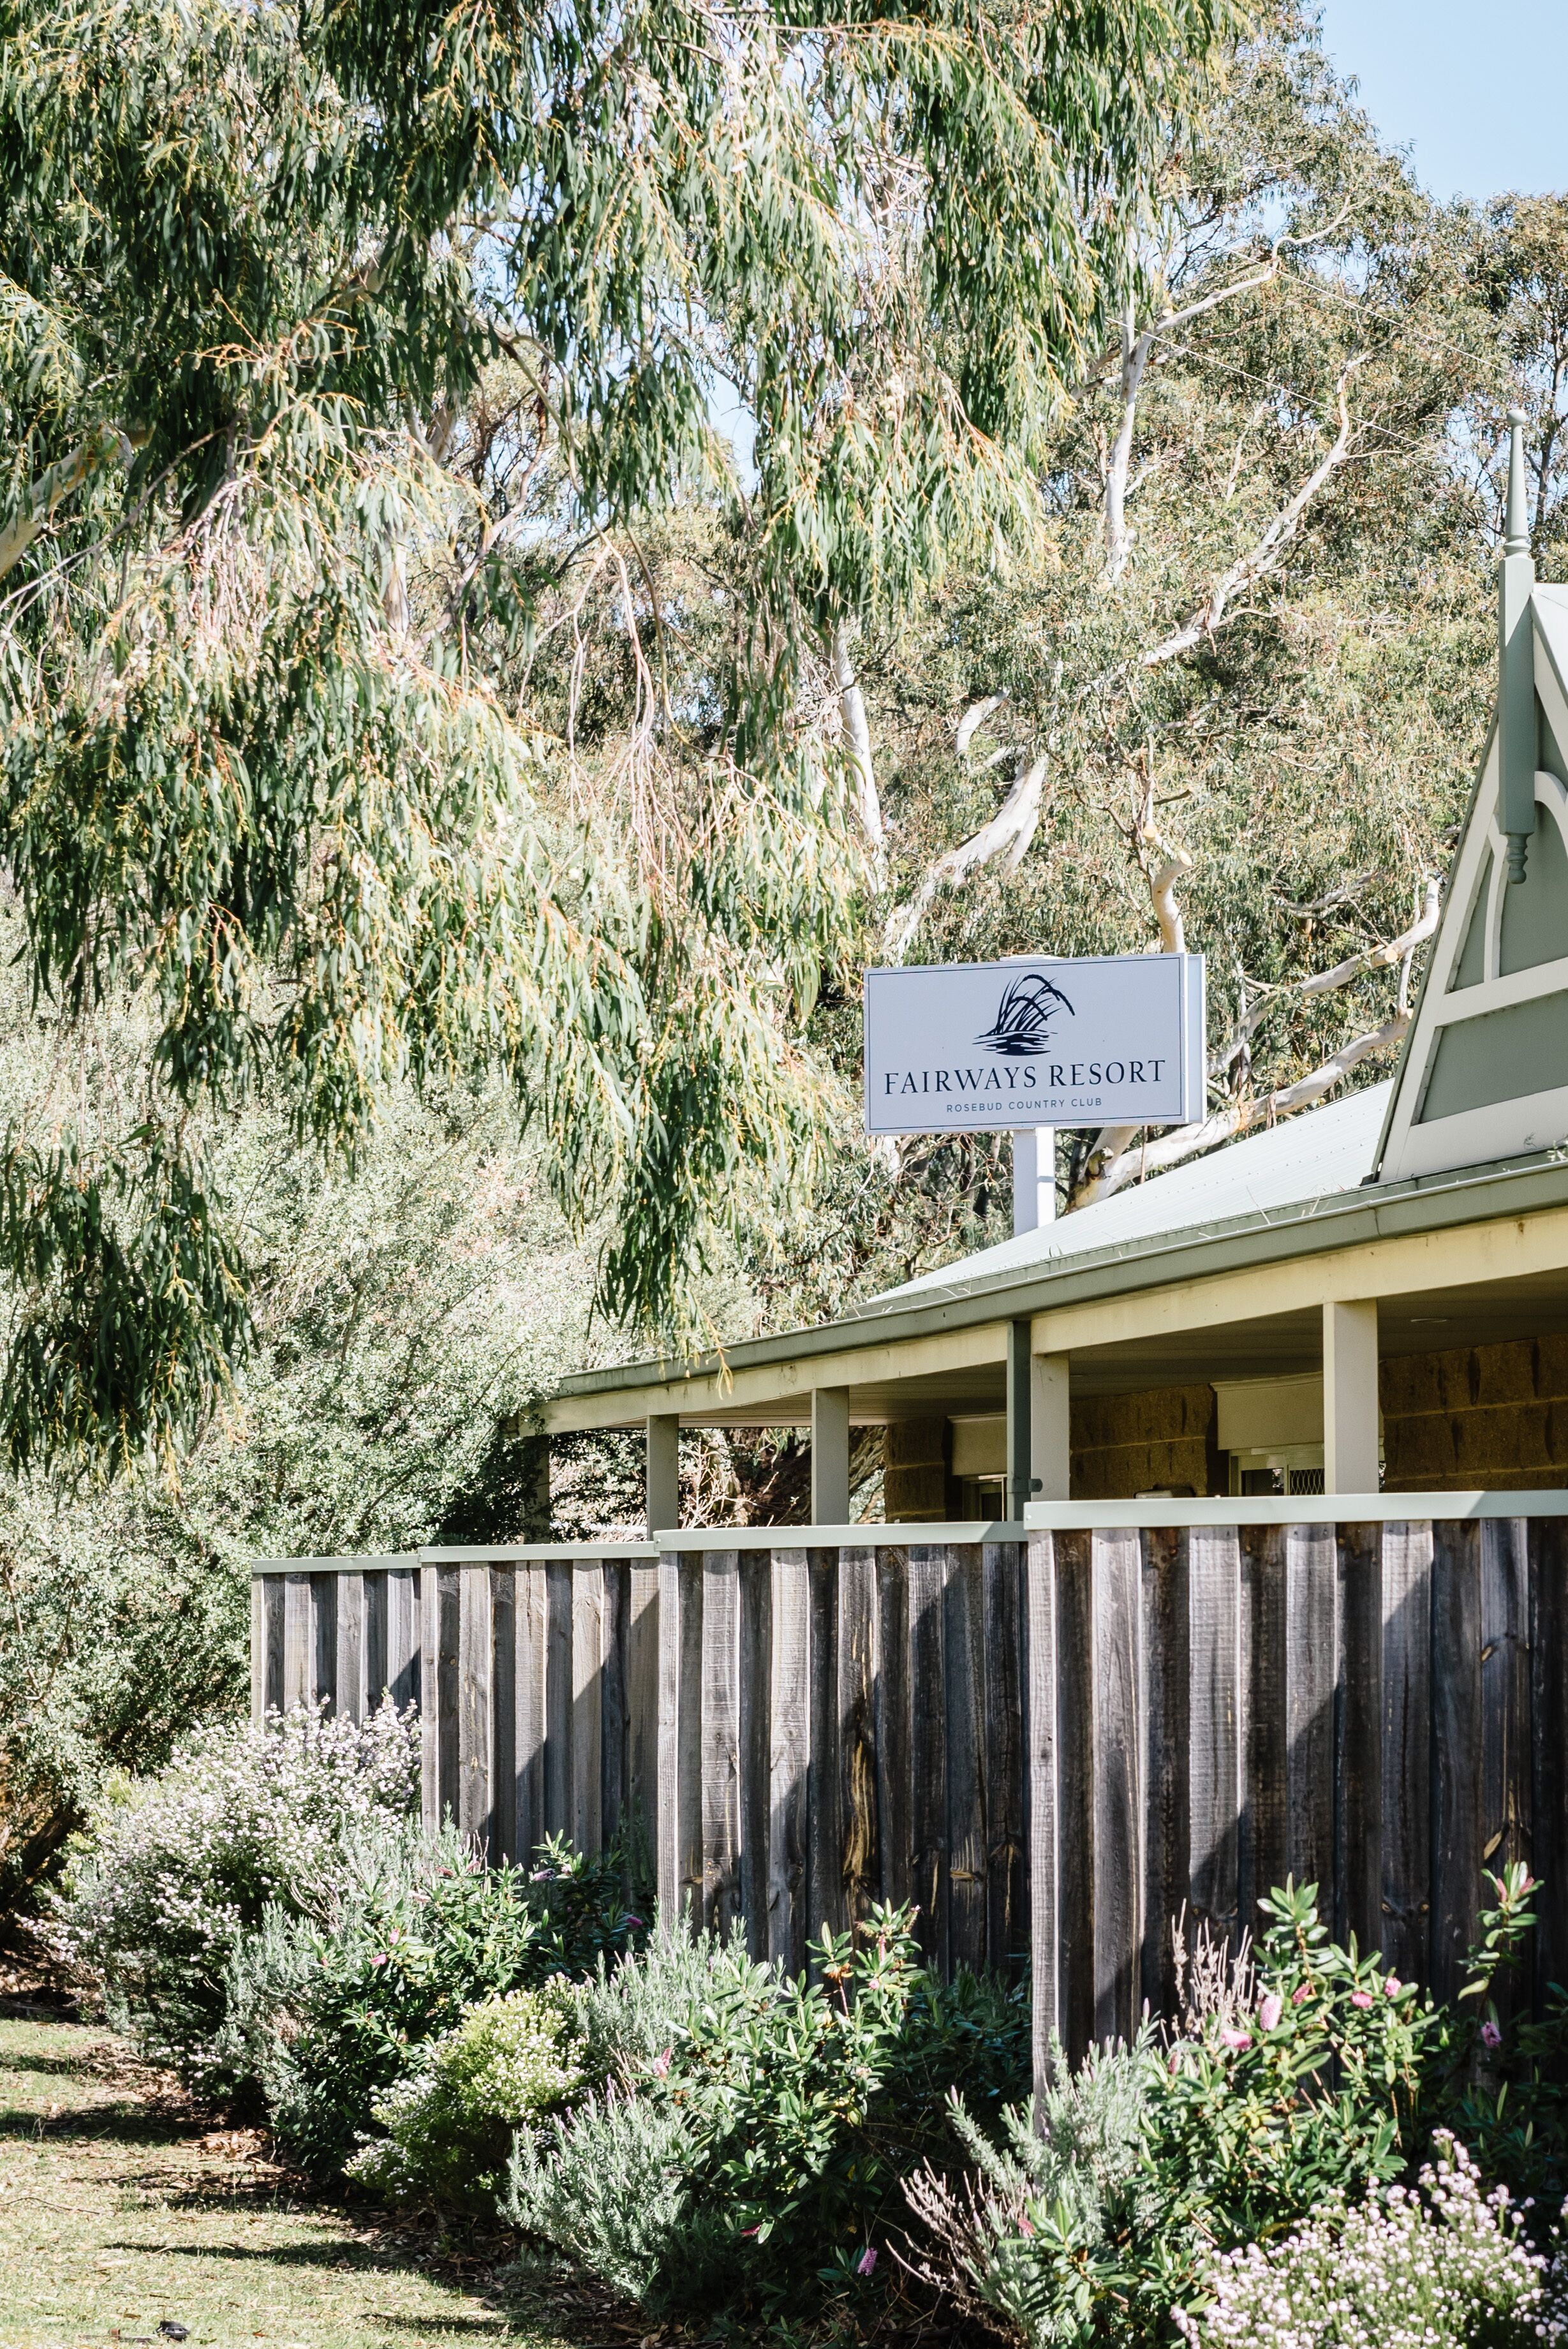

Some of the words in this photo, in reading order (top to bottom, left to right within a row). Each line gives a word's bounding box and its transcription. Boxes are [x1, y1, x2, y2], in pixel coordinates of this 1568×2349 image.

[884, 1066, 1037, 1095] FAIRWAYS
[1049, 1060, 1166, 1086] RESORT
[946, 1102, 1003, 1113] ROSEBUD
[1009, 1099, 1065, 1110] COUNTRY
[1071, 1097, 1102, 1107] CLUB
